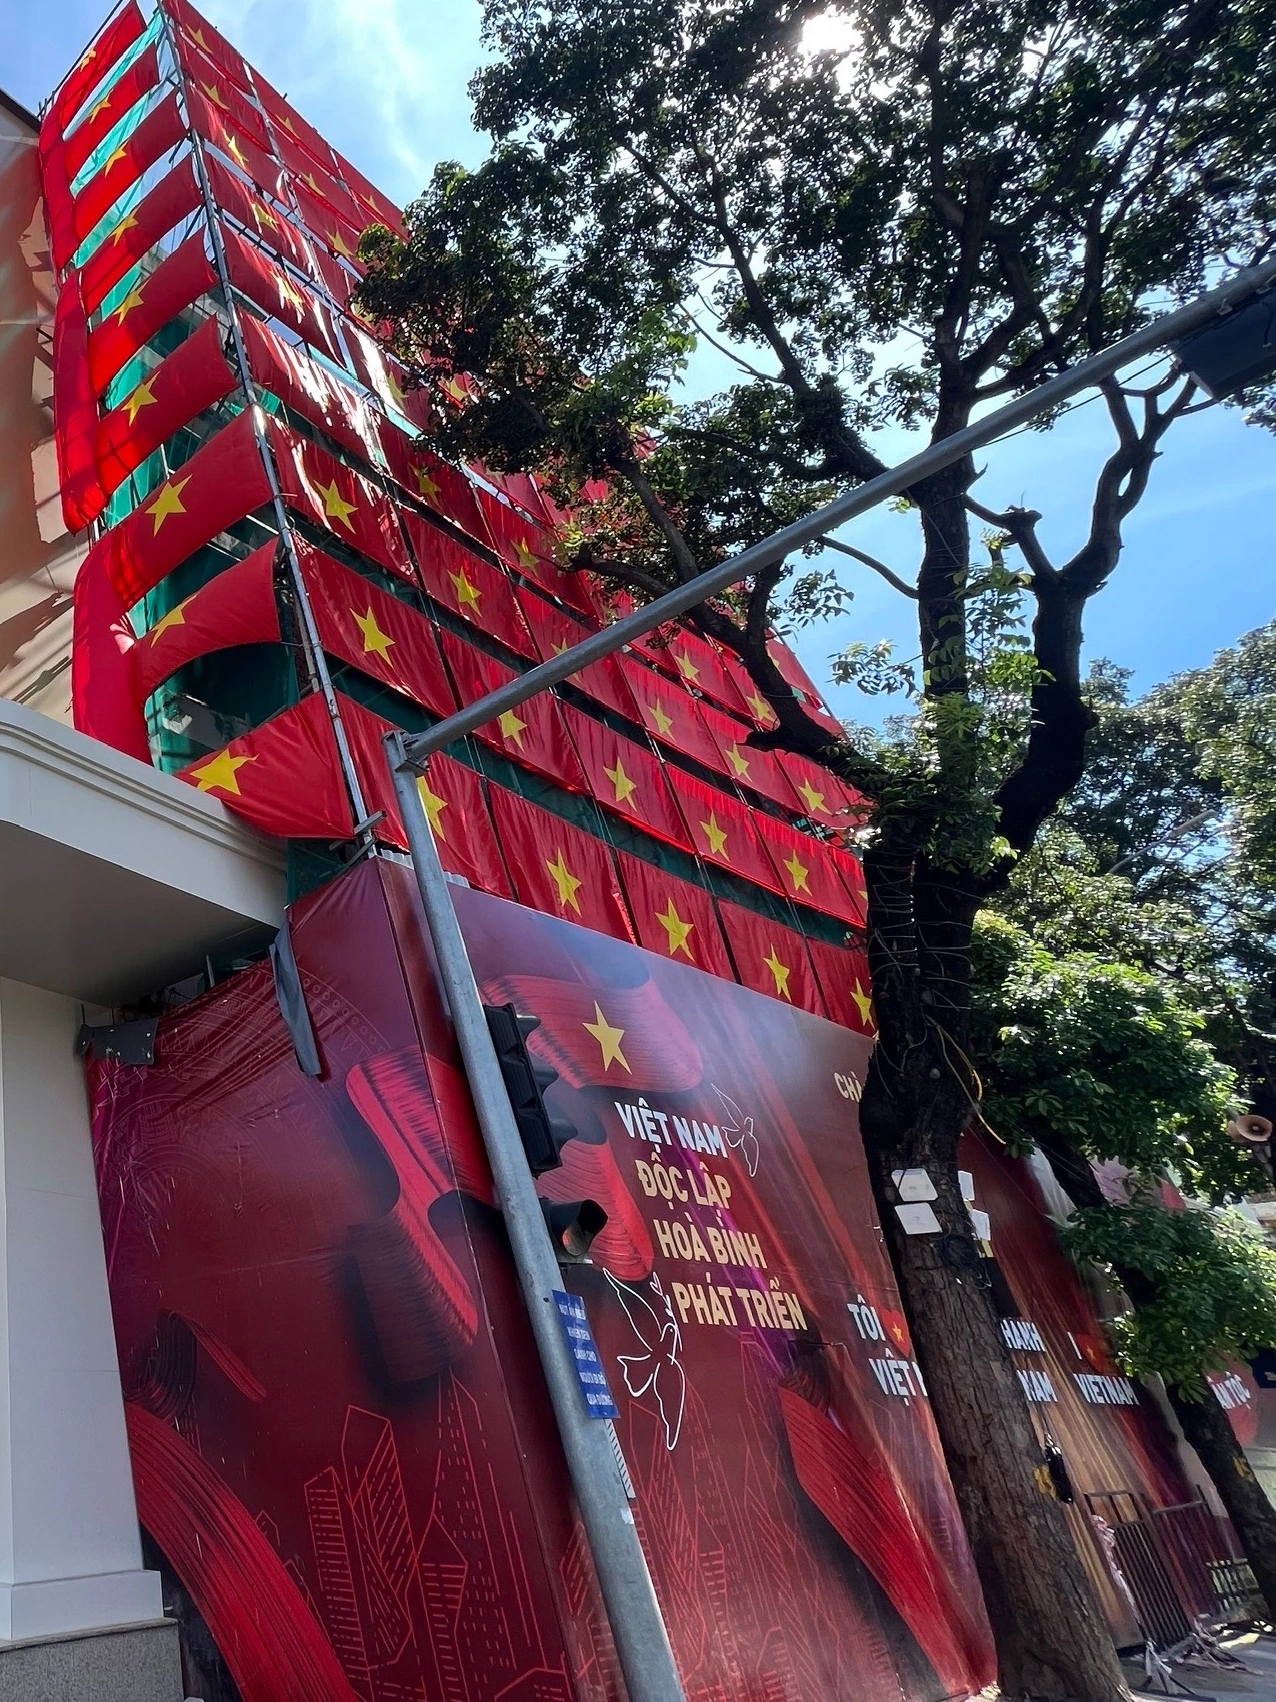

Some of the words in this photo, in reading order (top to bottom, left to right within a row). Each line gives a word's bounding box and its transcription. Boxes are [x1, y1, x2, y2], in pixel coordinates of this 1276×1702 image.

[614, 1097, 672, 1154] VIỆT
[672, 1115, 728, 1158] NAM
[635, 1152, 689, 1210] ĐỘC
[687, 1162, 731, 1216] LẬP
[653, 1212, 711, 1263] HOÀ
[707, 1215, 768, 1269] BÌNH
[671, 1272, 738, 1326] PHÁT
[736, 1276, 808, 1331] TRIỂN
[847, 1294, 886, 1341] TÔI
[868, 1347, 916, 1407] VIỆT
[1072, 1373, 1140, 1405] VIETNAM
